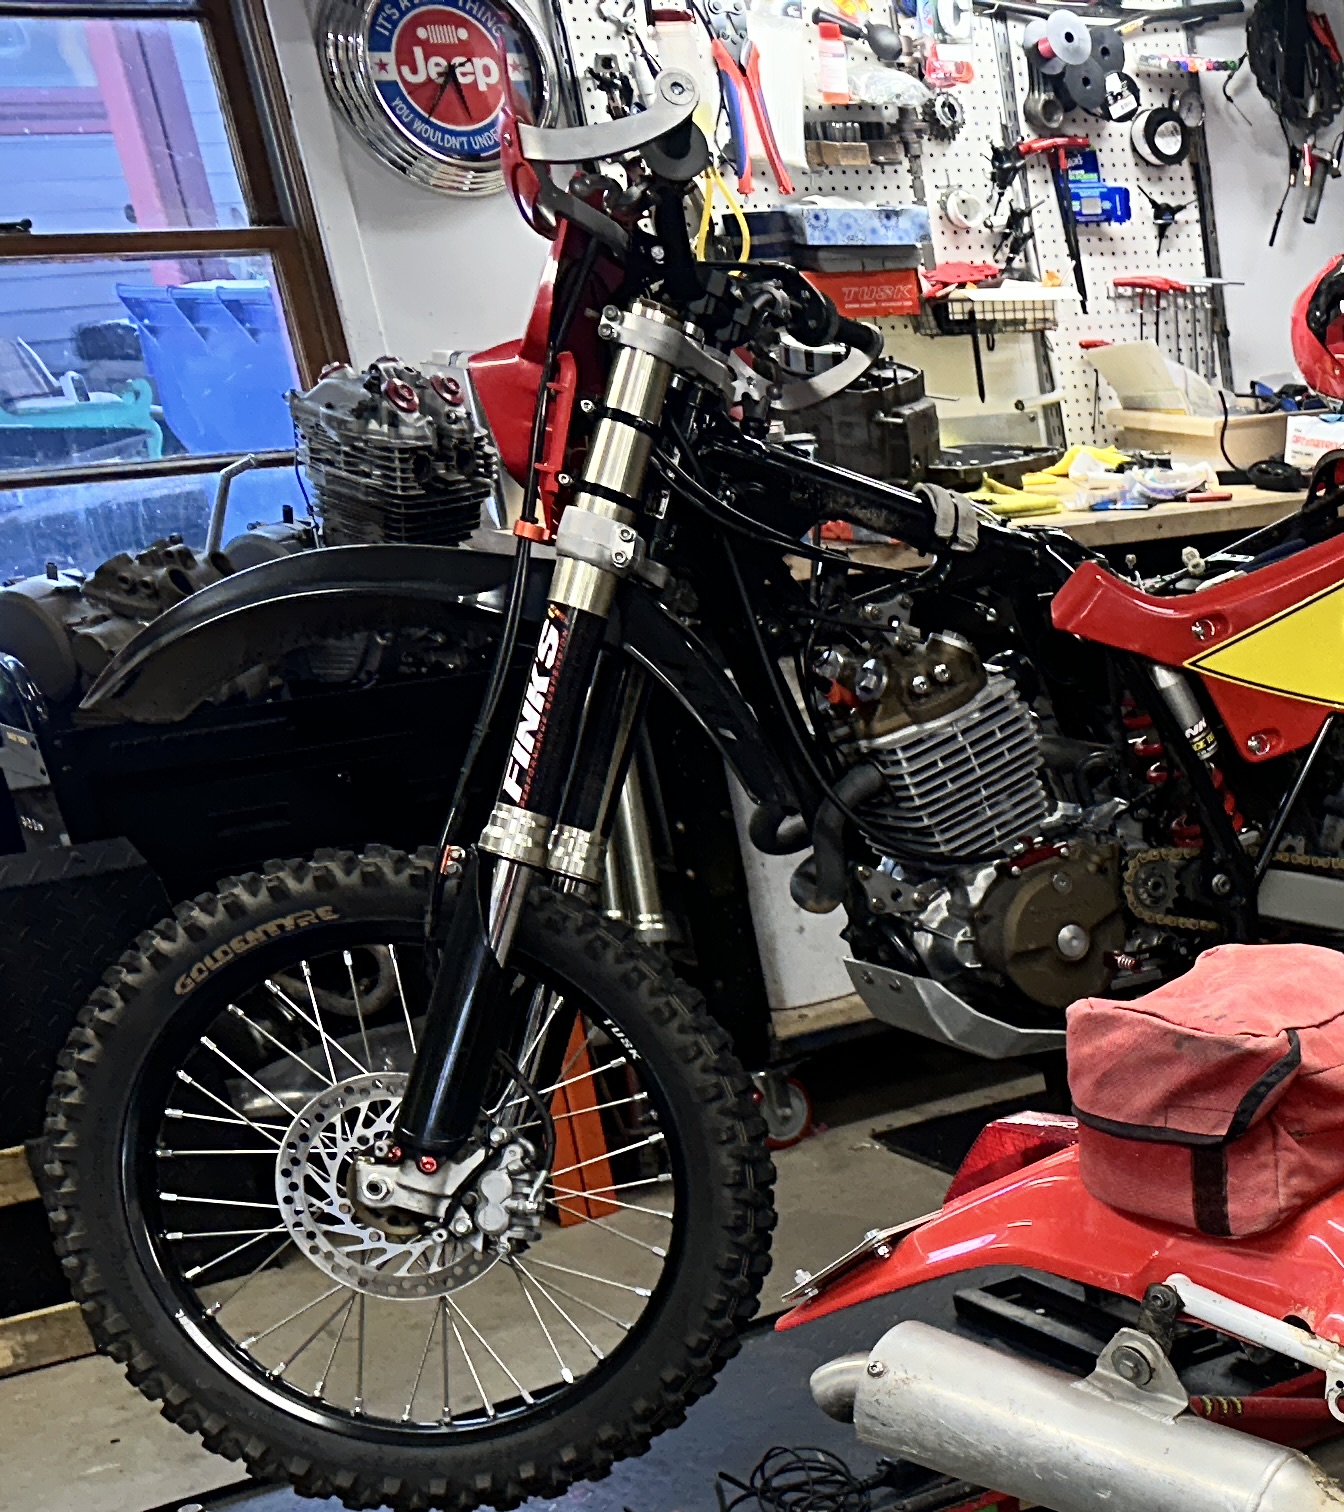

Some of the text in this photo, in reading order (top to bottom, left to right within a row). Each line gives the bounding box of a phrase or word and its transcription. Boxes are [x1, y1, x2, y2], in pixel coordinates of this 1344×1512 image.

[375, 3, 400, 36] IT'S
[400, 46, 500, 91] Jeep
[391, 97, 502, 151] YOU WOULDN'T UNDE
[842, 285, 912, 301] TUSK
[502, 618, 560, 804] FINK'S
[174, 905, 341, 996] GOLDENTYRE
[603, 1018, 641, 1060] TUSK
